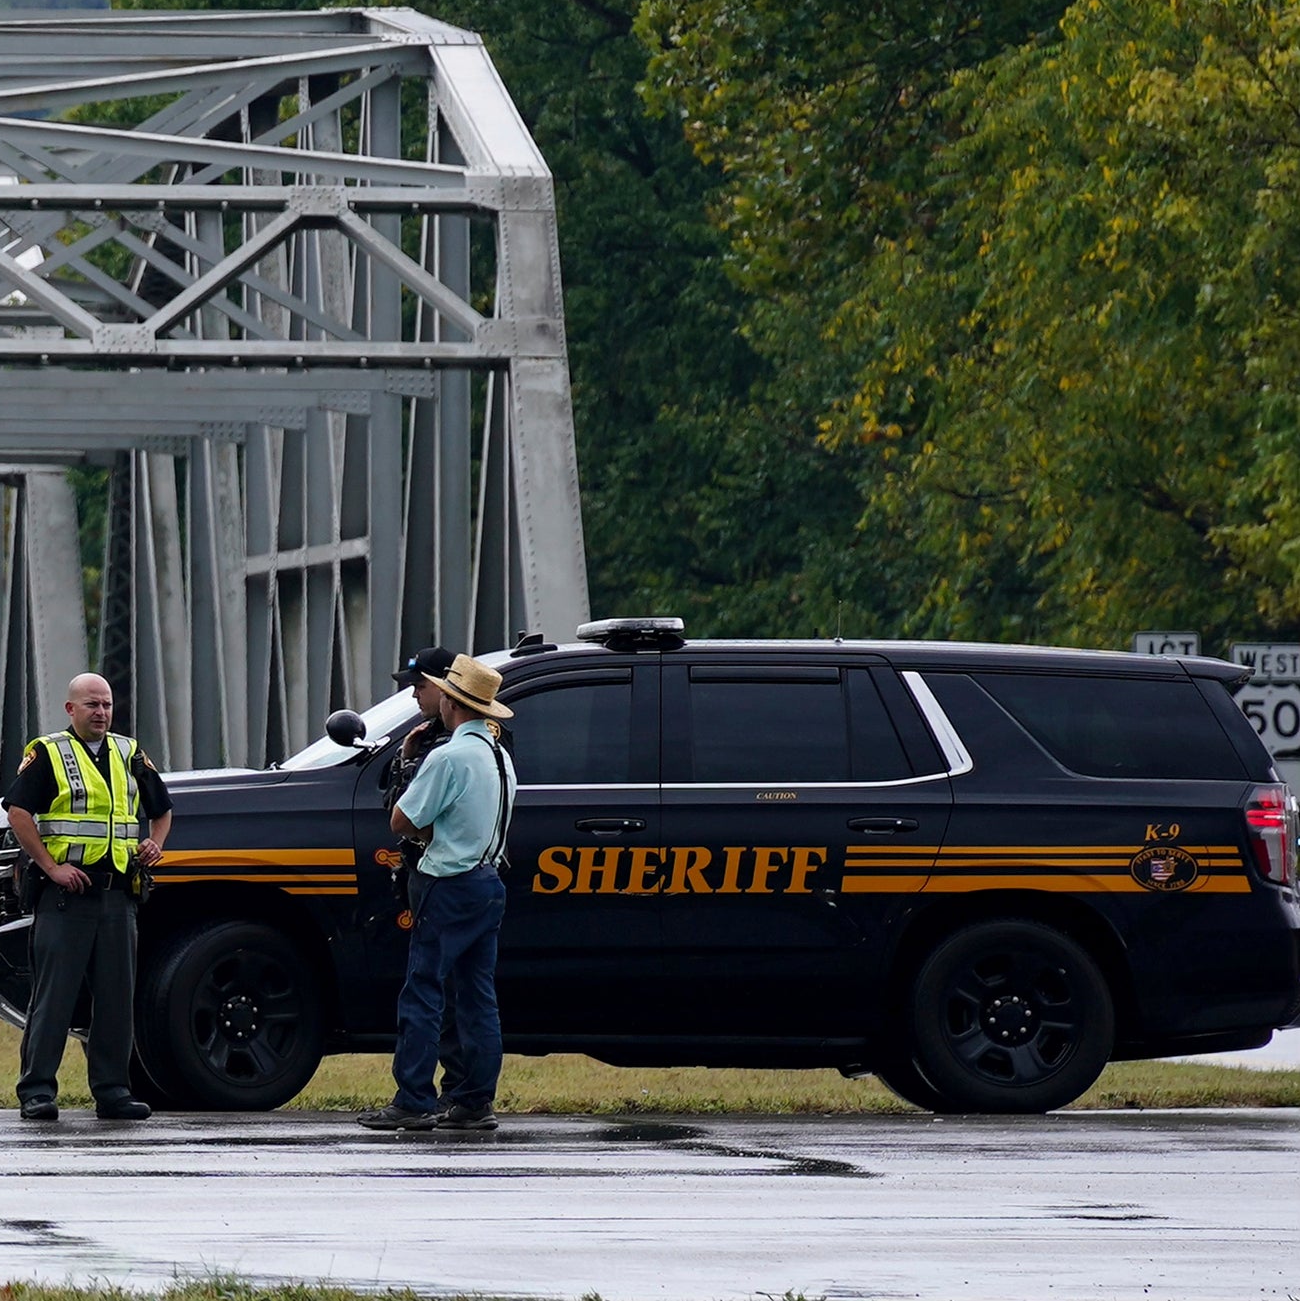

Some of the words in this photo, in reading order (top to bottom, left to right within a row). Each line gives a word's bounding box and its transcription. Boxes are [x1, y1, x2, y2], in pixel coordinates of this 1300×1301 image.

[1240, 651, 1300, 674] WEST
[1242, 699, 1300, 738] 50
[756, 791, 797, 800] CAUTION
[1145, 823, 1180, 841] K-9
[532, 846, 827, 894] SHERIFF
